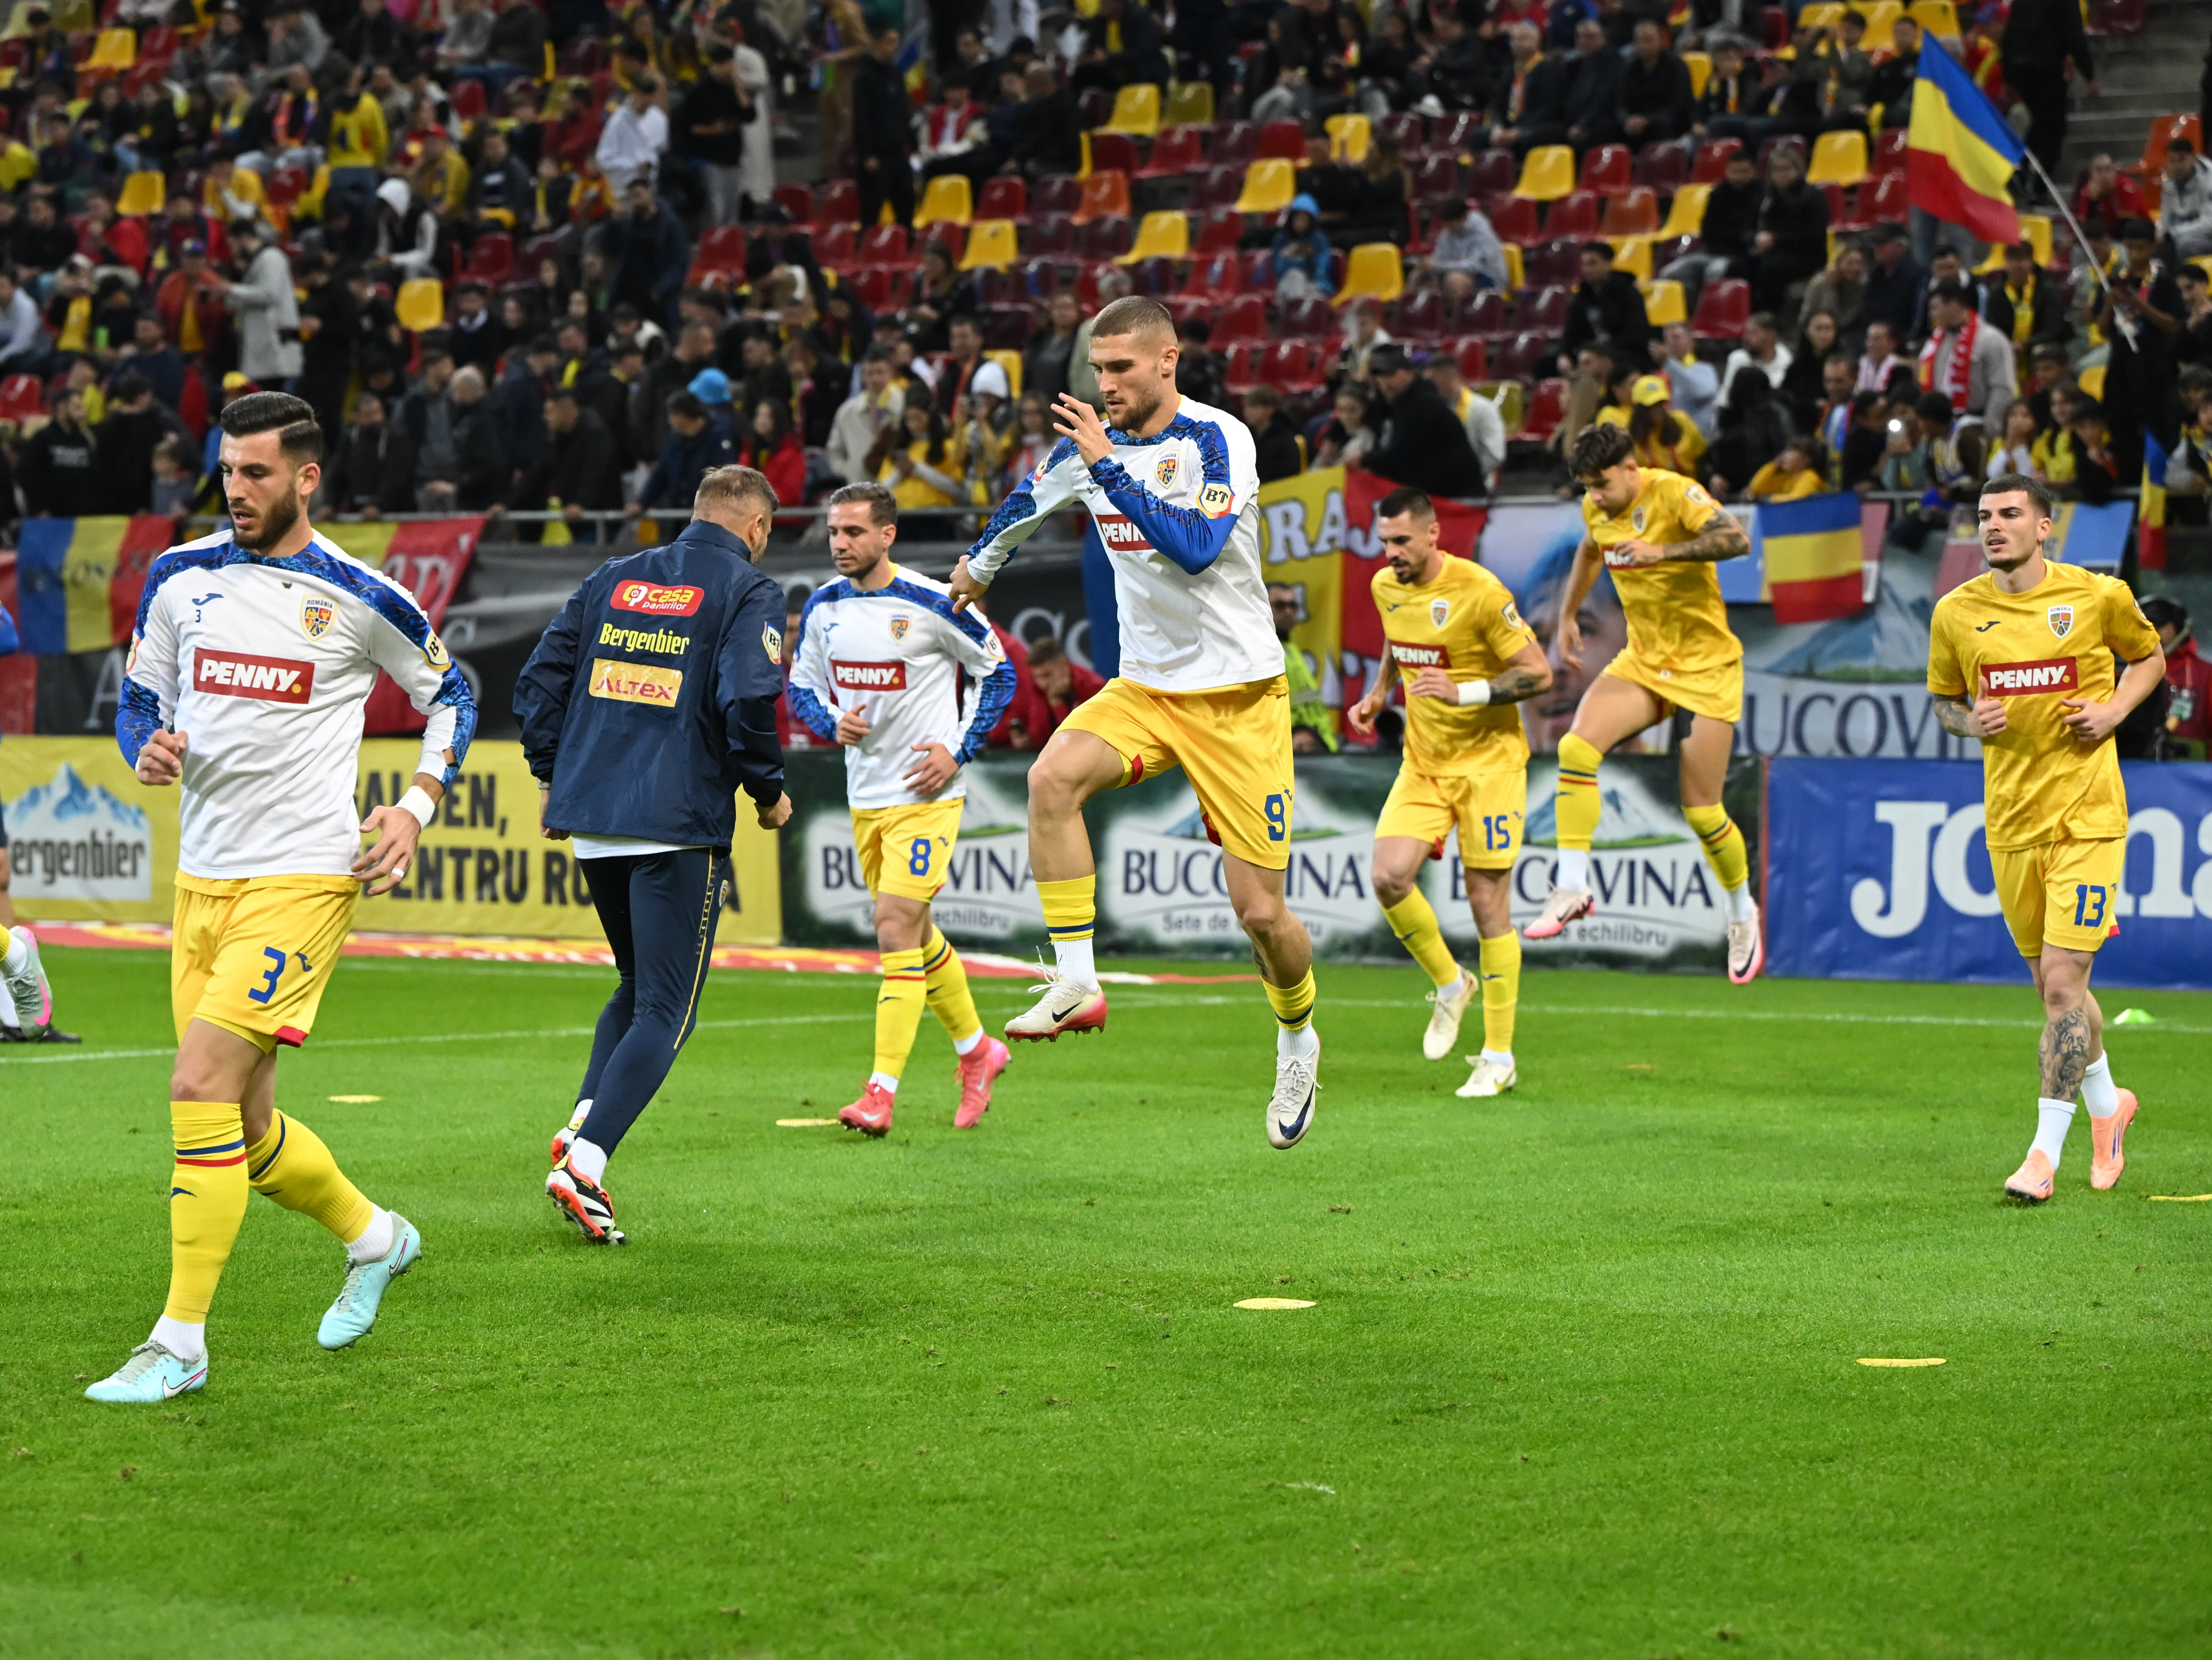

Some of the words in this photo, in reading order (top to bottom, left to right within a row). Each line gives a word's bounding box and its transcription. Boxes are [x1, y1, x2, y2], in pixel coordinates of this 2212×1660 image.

[1205, 488, 1228, 505] BT
[1101, 523, 1146, 542] PENN
[1258, 489, 1384, 564] RAJ
[306, 599, 333, 608] ROMÂNIA
[642, 601, 687, 610] pariurilor
[648, 589, 694, 603] casa
[195, 609, 201, 623] 3
[429, 636, 439, 657] B
[598, 623, 690, 655] Bergenbier
[1728, 692, 1965, 758] UCOV
[1264, 794, 1286, 841] 9
[1483, 815, 1510, 850] 15
[8, 827, 146, 886] ergenbier
[821, 845, 1034, 893] BUVIN
[909, 838, 931, 876] 8
[1123, 849, 1366, 899] BUCINA
[1208, 913, 1230, 931] de
[2075, 884, 2107, 927] 13
[1577, 922, 1668, 946] echilibru
[247, 946, 286, 1004] 3
